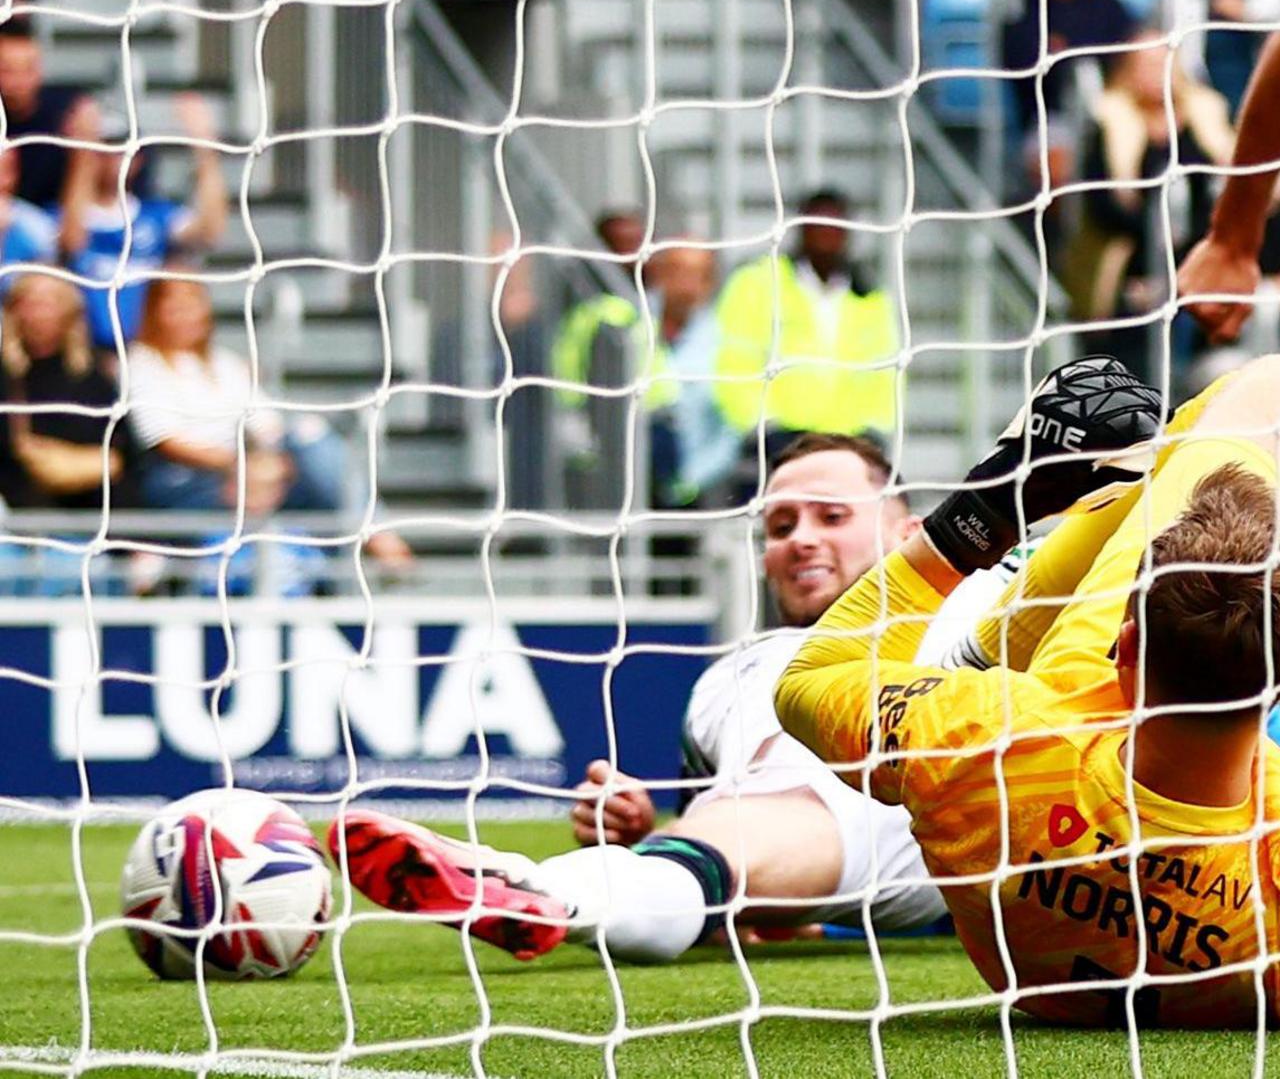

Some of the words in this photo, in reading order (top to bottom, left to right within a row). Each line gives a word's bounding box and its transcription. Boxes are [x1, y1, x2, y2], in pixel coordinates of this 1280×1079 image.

[953, 514, 991, 552] NORRIS
[50, 620, 566, 762] LUNA
[1016, 849, 1231, 974] NORRIS
[1092, 831, 1254, 911] TOTALAV
